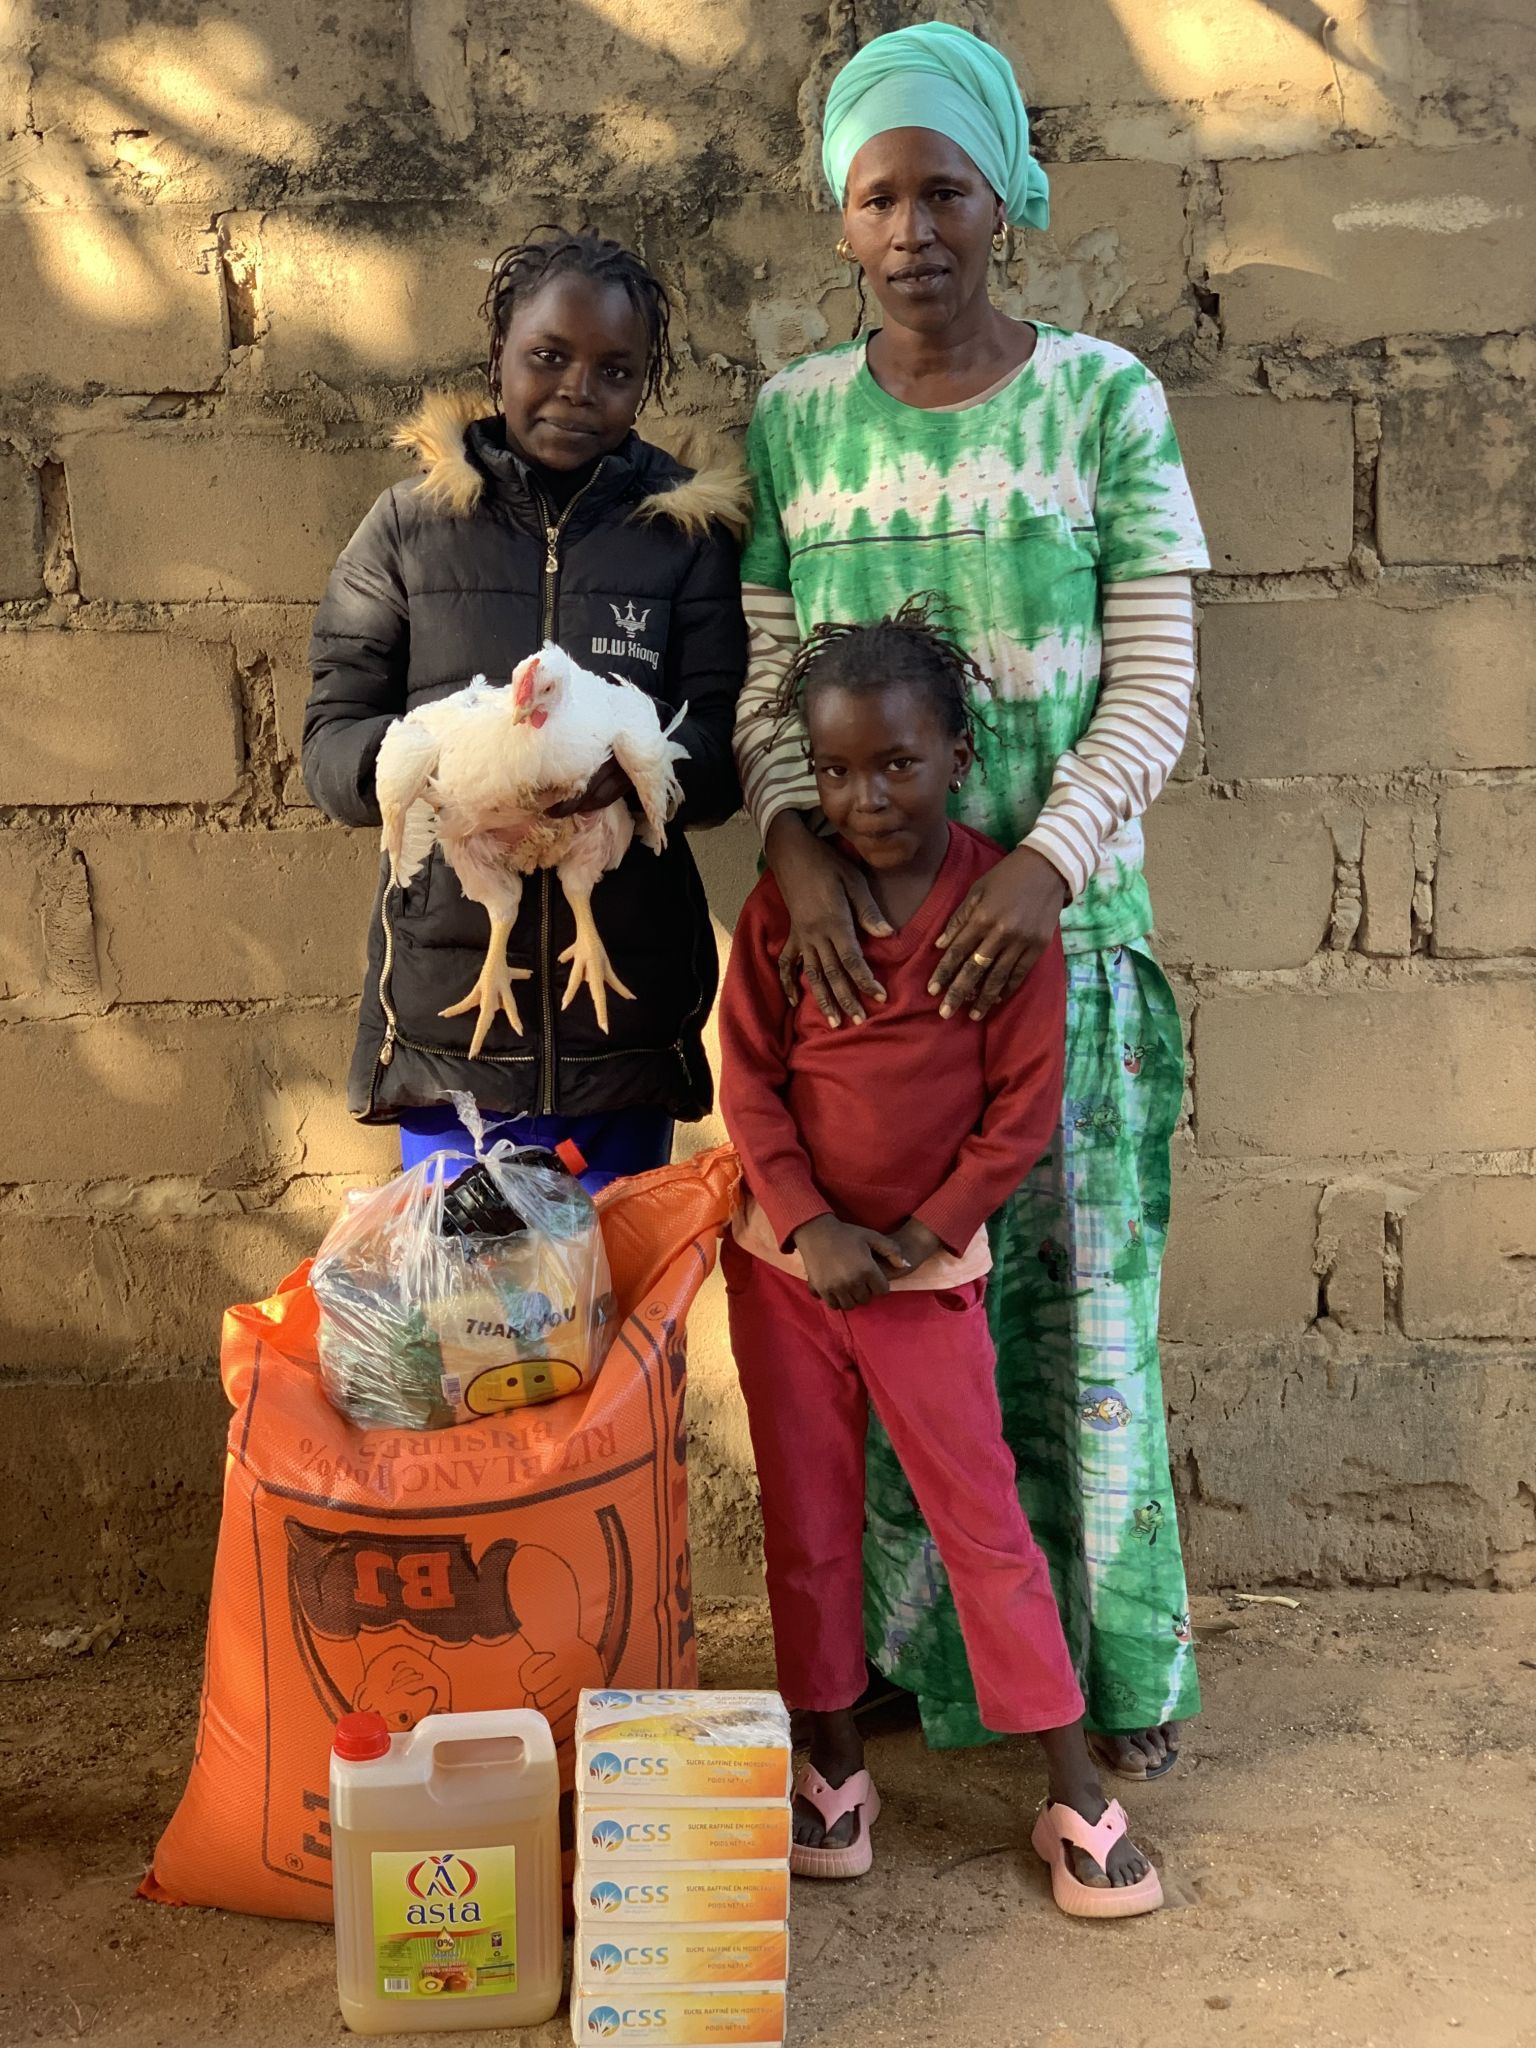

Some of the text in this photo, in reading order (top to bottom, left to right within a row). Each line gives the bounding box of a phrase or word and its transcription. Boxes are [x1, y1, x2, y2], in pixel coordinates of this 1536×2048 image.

[401, 1455, 541, 1493] BLANC
[354, 1551, 455, 1610] BJ
[635, 1693, 698, 1707] CSS
[624, 1757, 669, 1776] CSS
[626, 1823, 671, 1842] CSS
[624, 1885, 669, 1904] CSS
[406, 1901, 482, 1925] asta
[624, 1947, 669, 1966] CSS
[622, 2009, 667, 2028] CSS
